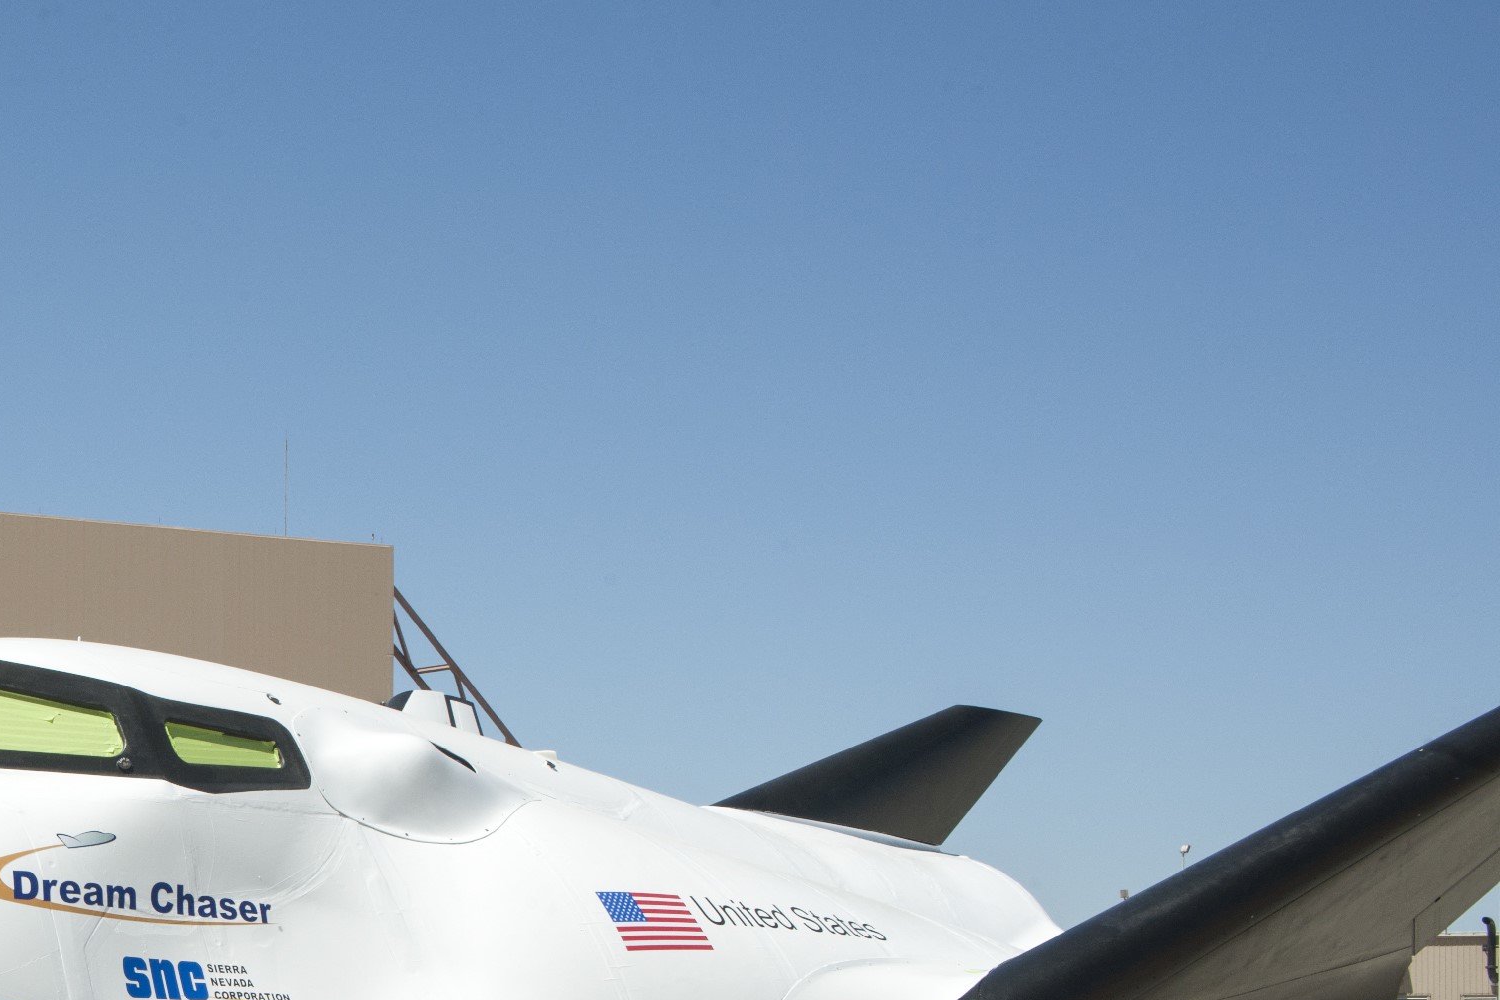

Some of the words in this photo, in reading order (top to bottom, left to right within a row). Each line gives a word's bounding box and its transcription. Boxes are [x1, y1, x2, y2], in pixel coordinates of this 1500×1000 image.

[12, 870, 137, 911] Dream
[150, 881, 271, 924] Chaser
[689, 896, 797, 930] United
[790, 906, 887, 941] States
[207, 964, 248, 975] SIERRA
[210, 977, 254, 988] NEVADA
